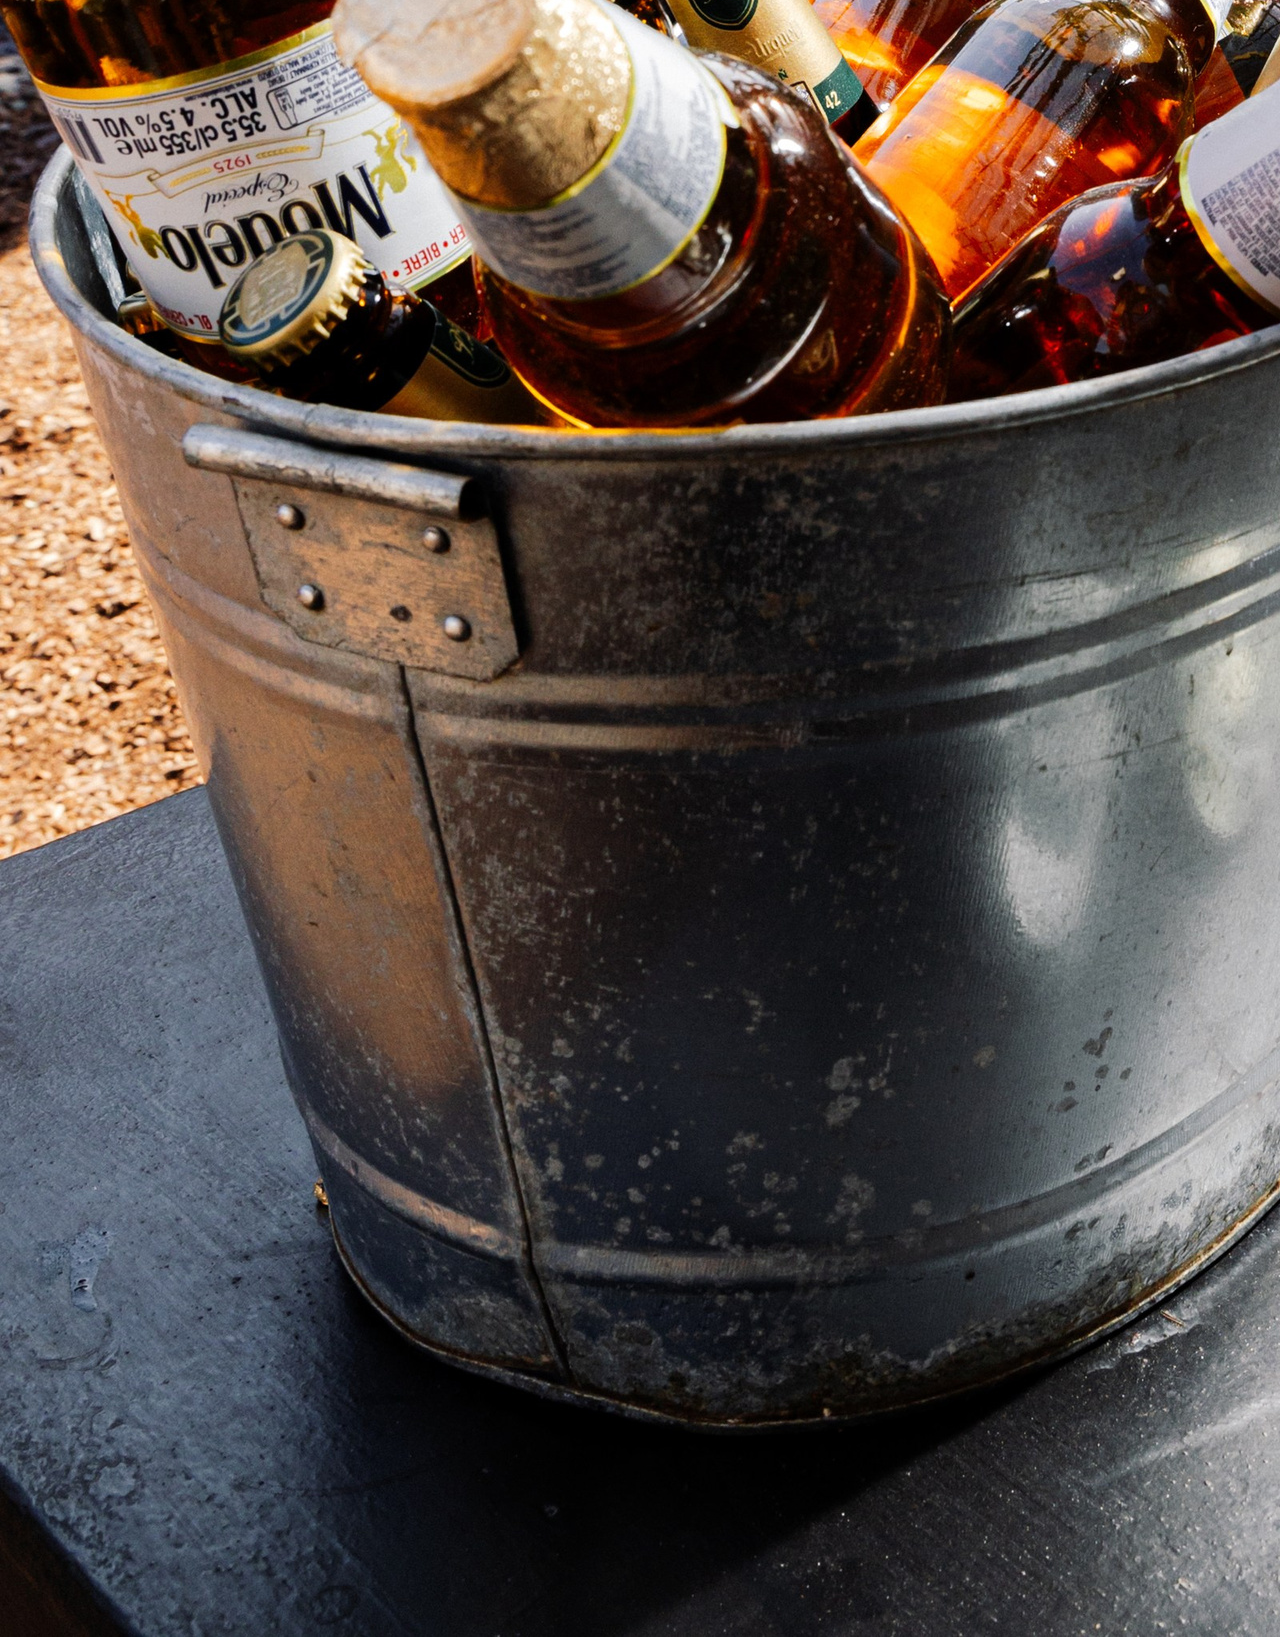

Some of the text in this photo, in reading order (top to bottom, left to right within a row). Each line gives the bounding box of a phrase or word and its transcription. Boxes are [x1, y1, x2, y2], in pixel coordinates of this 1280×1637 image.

[200, 85, 260, 123] ALC.
[91, 117, 134, 138] VOL
[218, 109, 267, 143] 35.5
[211, 153, 252, 173] 1925
[202, 172, 297, 213] Especial
[400, 241, 441, 275] BIERE
